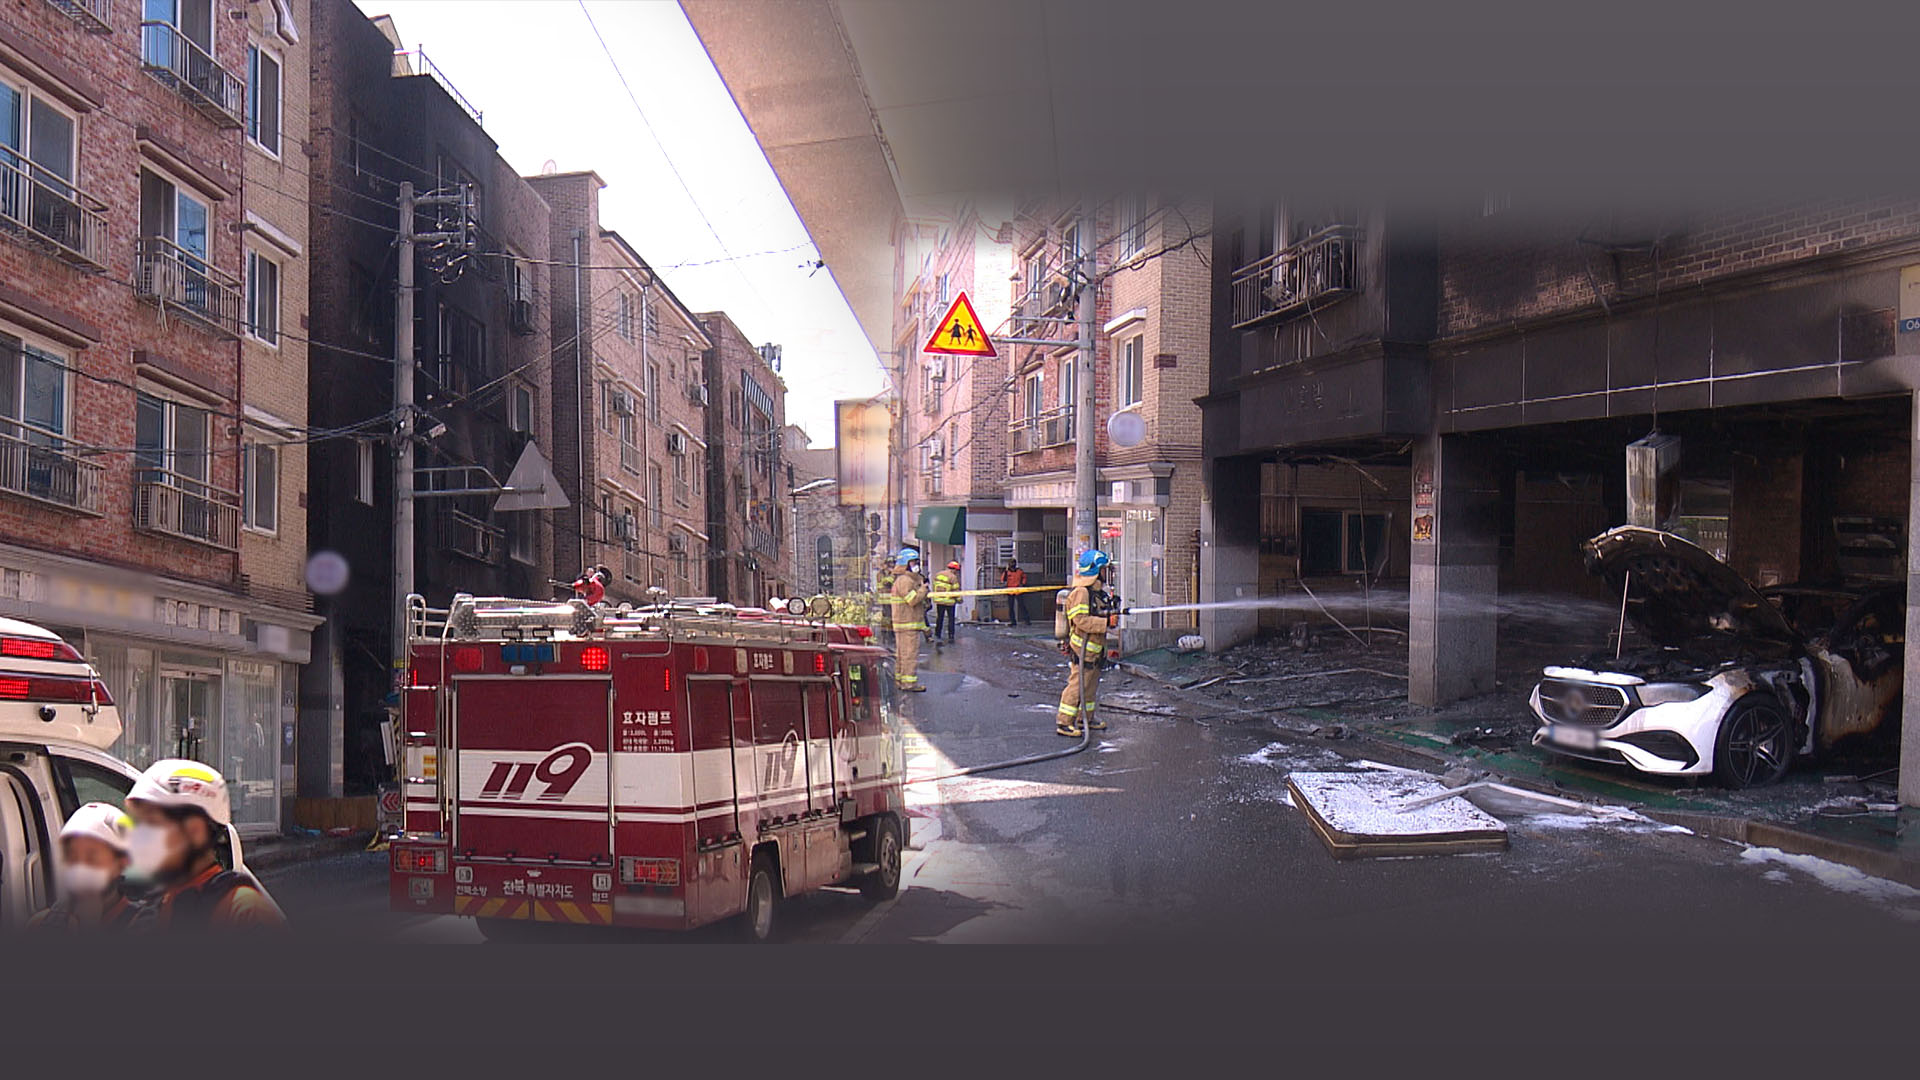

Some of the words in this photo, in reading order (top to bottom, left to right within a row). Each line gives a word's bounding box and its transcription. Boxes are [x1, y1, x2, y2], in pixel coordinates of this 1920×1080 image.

[753, 653, 774, 670] 효자펌프
[622, 711, 672, 725] 효자펌프
[478, 743, 593, 802] 119
[763, 730, 799, 791] 119
